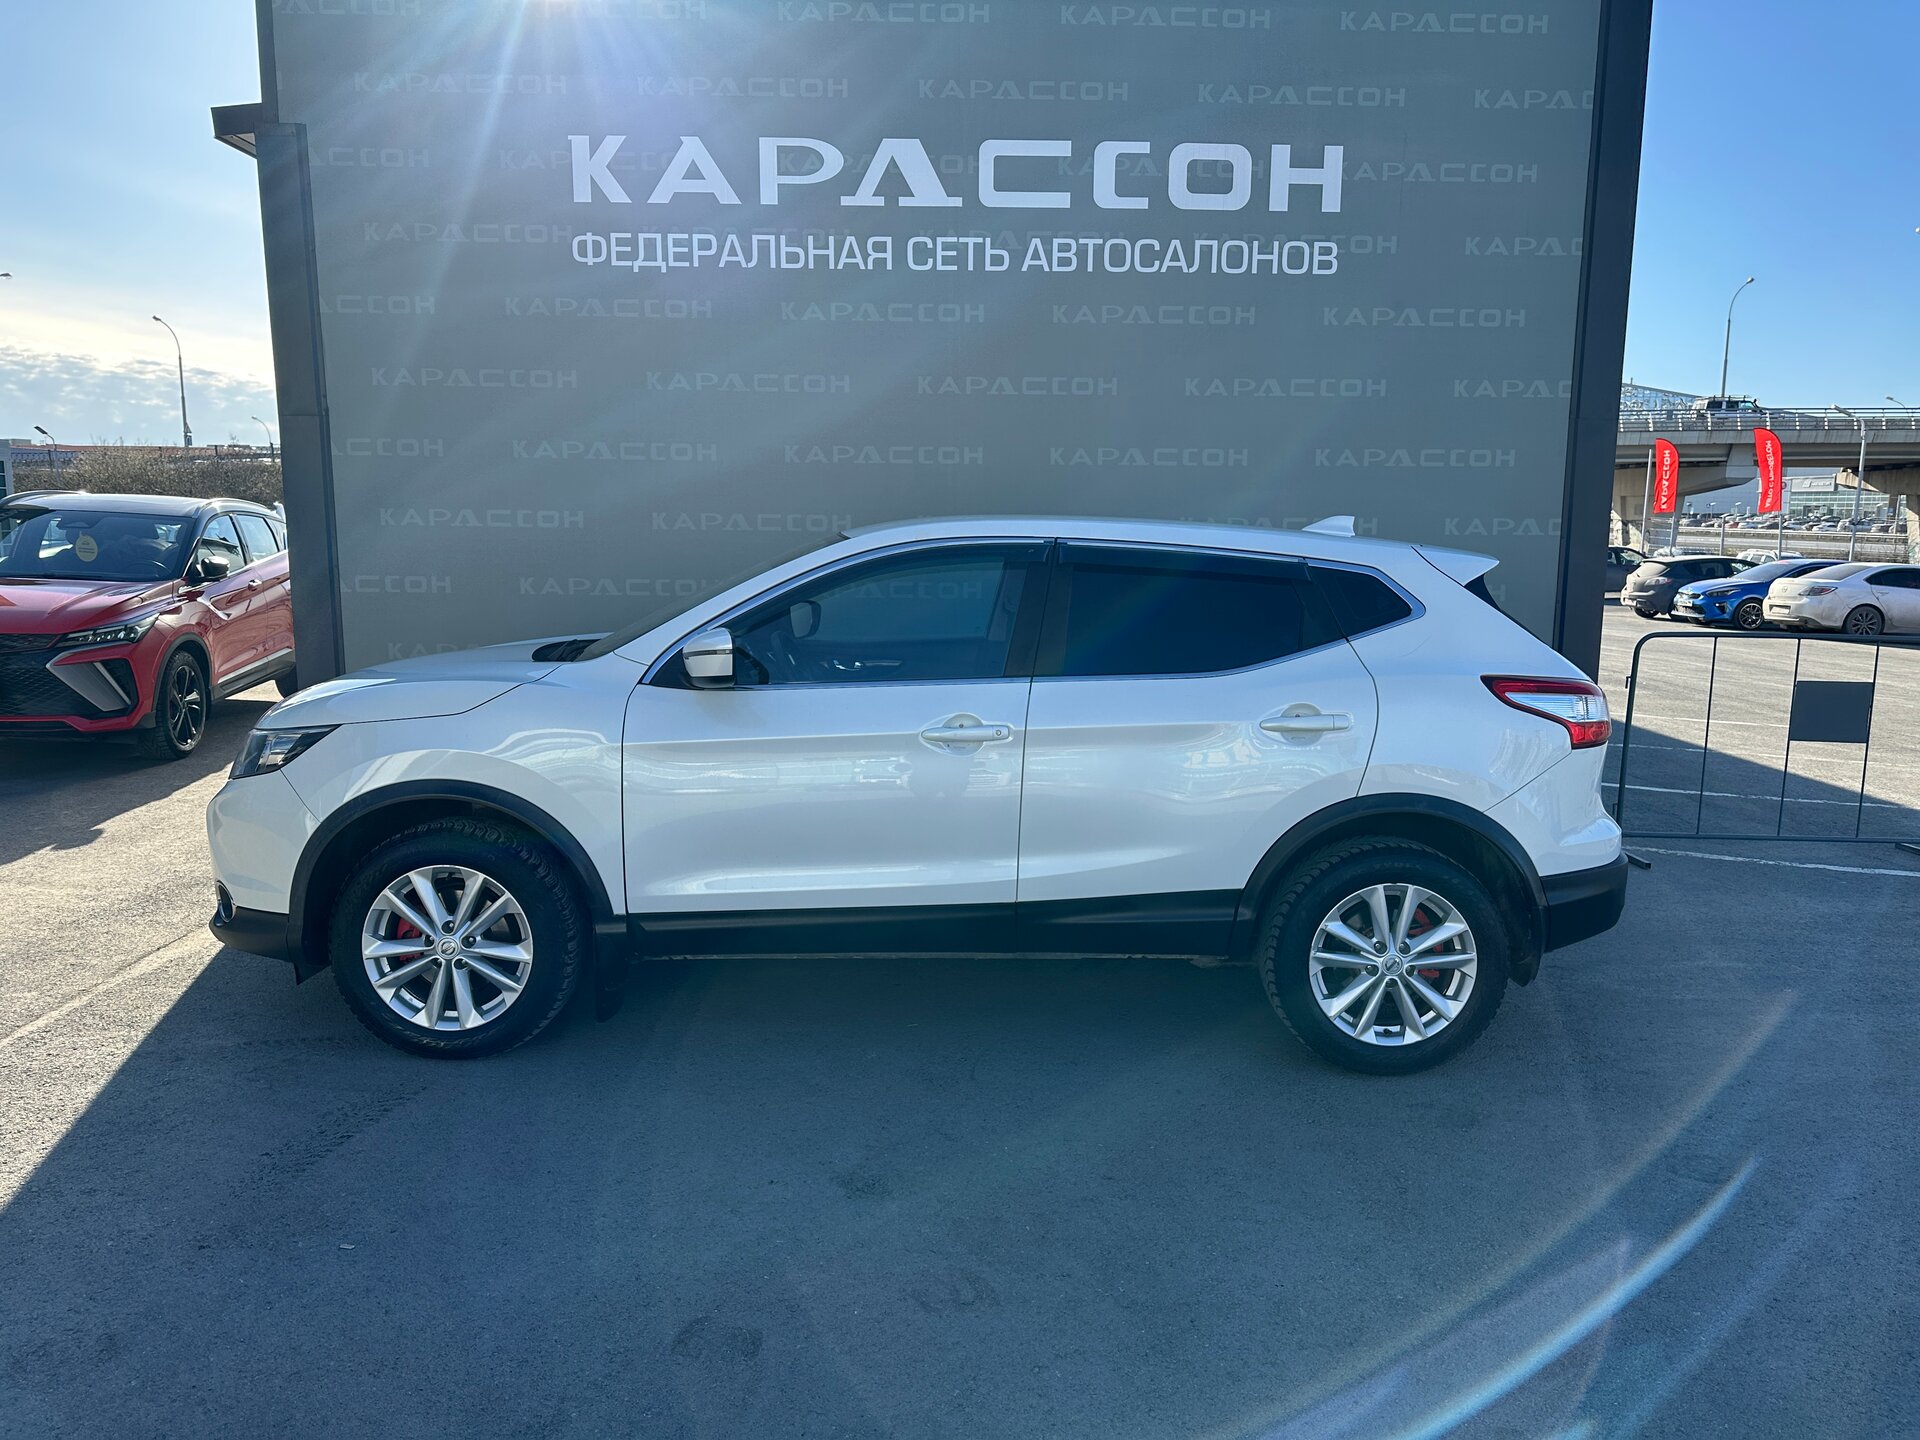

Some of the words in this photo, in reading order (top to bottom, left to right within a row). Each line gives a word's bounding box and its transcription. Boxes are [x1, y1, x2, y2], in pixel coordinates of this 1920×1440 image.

[568, 134, 1344, 213] КАРЛССОН
[571, 231, 893, 272] ФЕДЕРАЛЬНАЯ
[906, 235, 1010, 272] СЕТЬ
[1021, 237, 1339, 275] АВТОСАЛОНОВ
